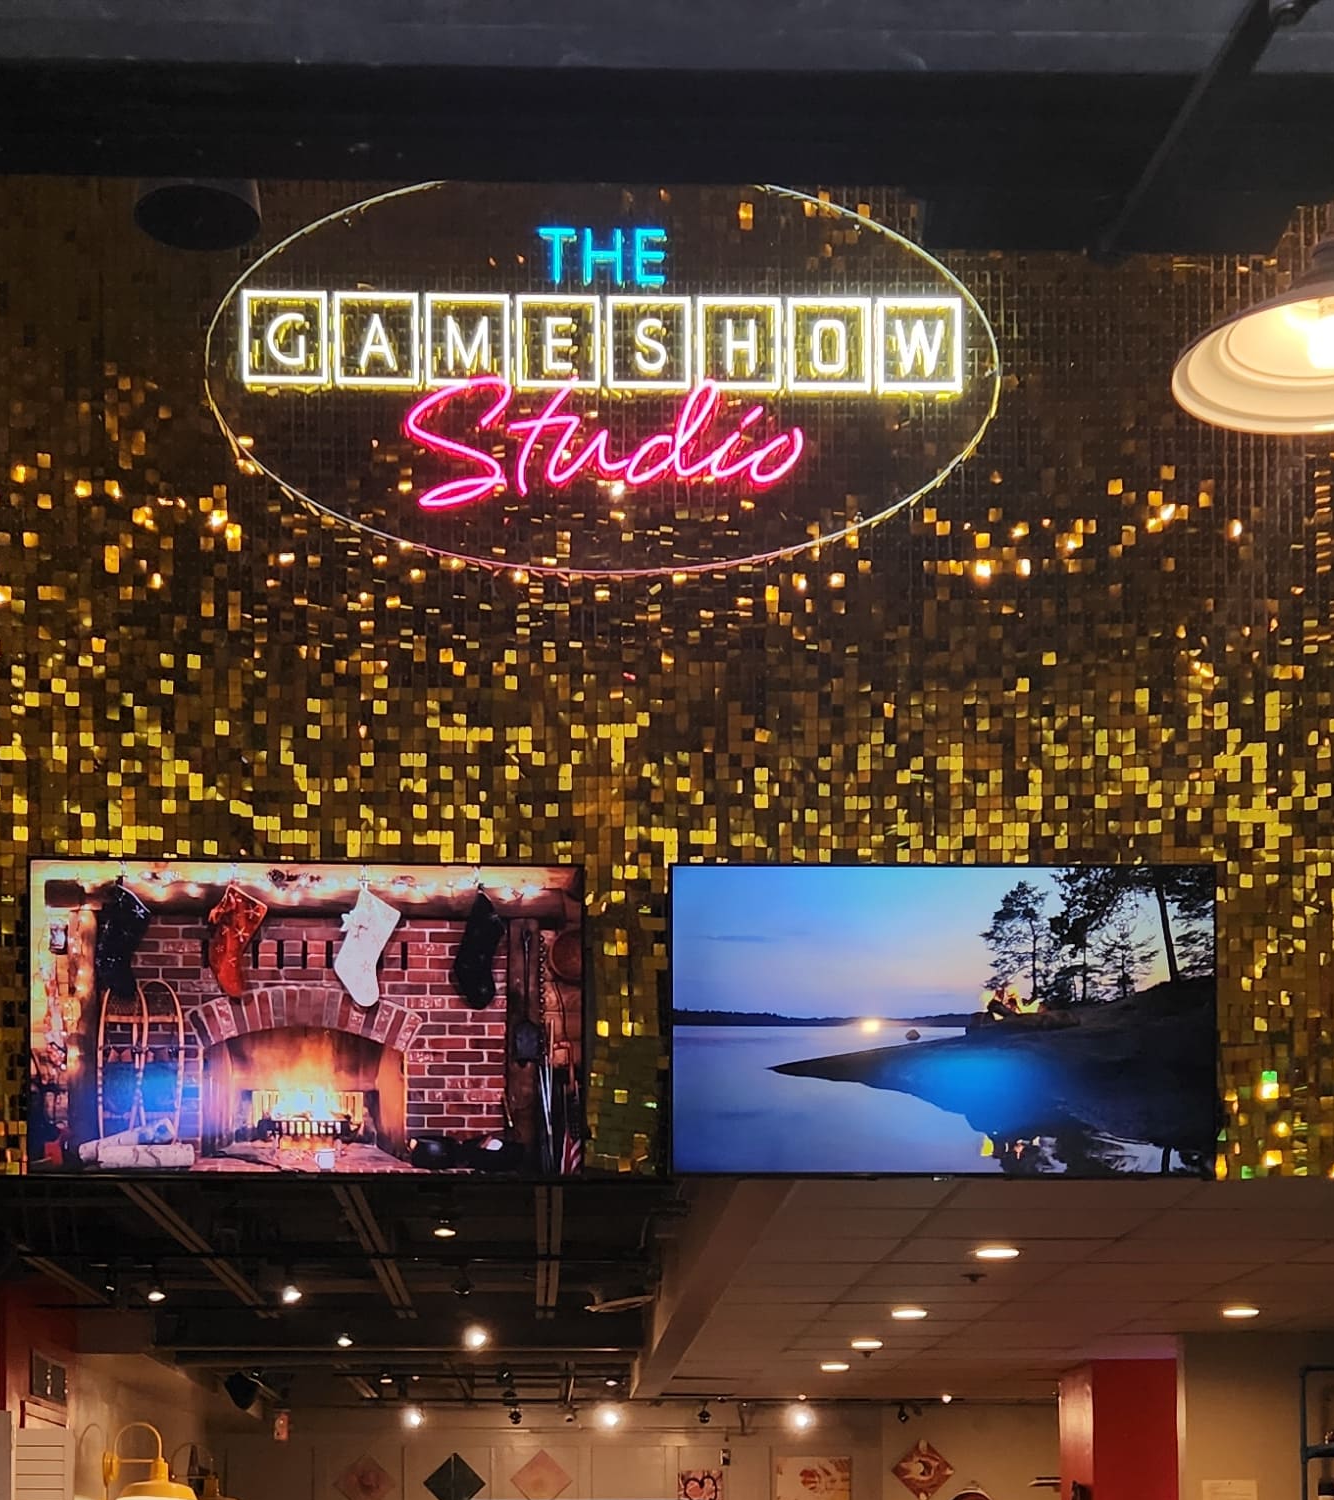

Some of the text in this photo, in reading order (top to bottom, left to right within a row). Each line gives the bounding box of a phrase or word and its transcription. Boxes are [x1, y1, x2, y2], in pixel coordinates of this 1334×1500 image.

[535, 225, 670, 286] THE
[261, 307, 951, 380] GAMESHOW
[403, 374, 805, 512] Studio
